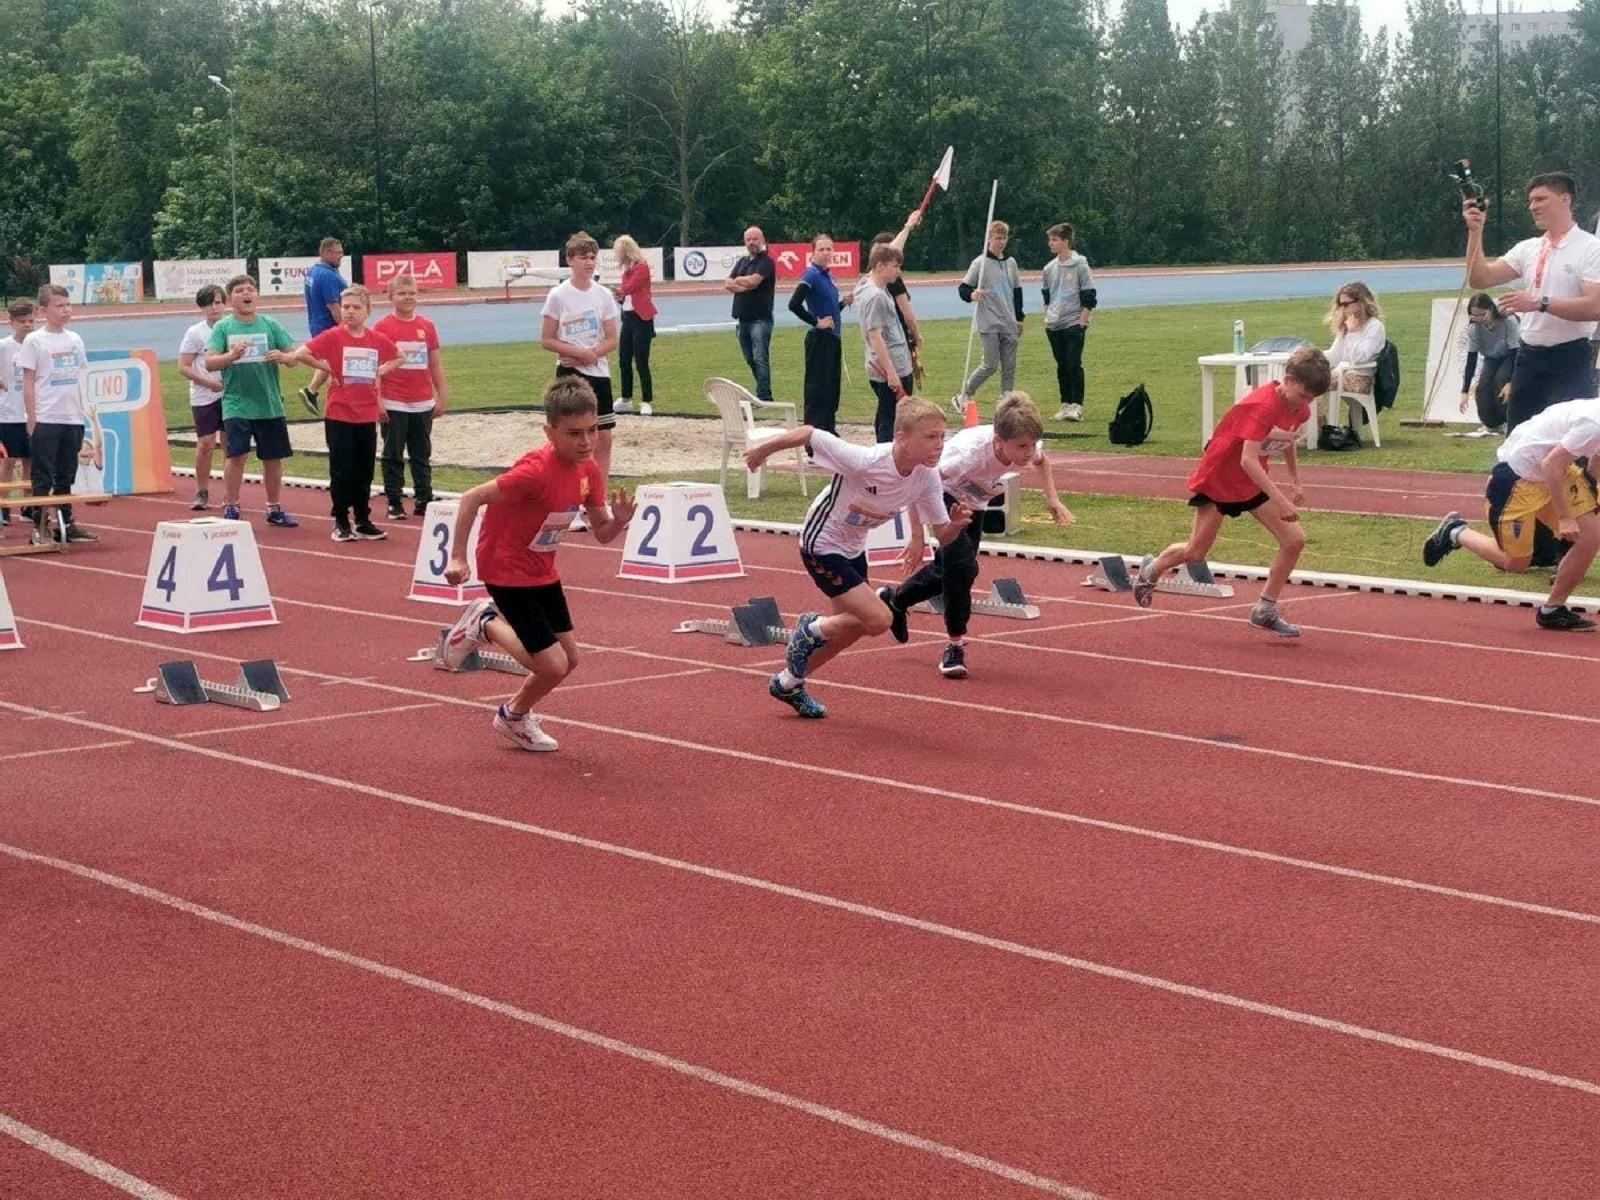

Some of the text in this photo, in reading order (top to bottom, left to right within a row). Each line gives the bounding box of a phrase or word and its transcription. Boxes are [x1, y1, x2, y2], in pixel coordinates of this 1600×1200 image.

[376, 259, 443, 279] PZLA
[429, 522, 449, 577] 3
[638, 505, 661, 557] 2
[687, 504, 718, 557] 2
[156, 545, 177, 602] 4
[207, 543, 245, 601] 4
